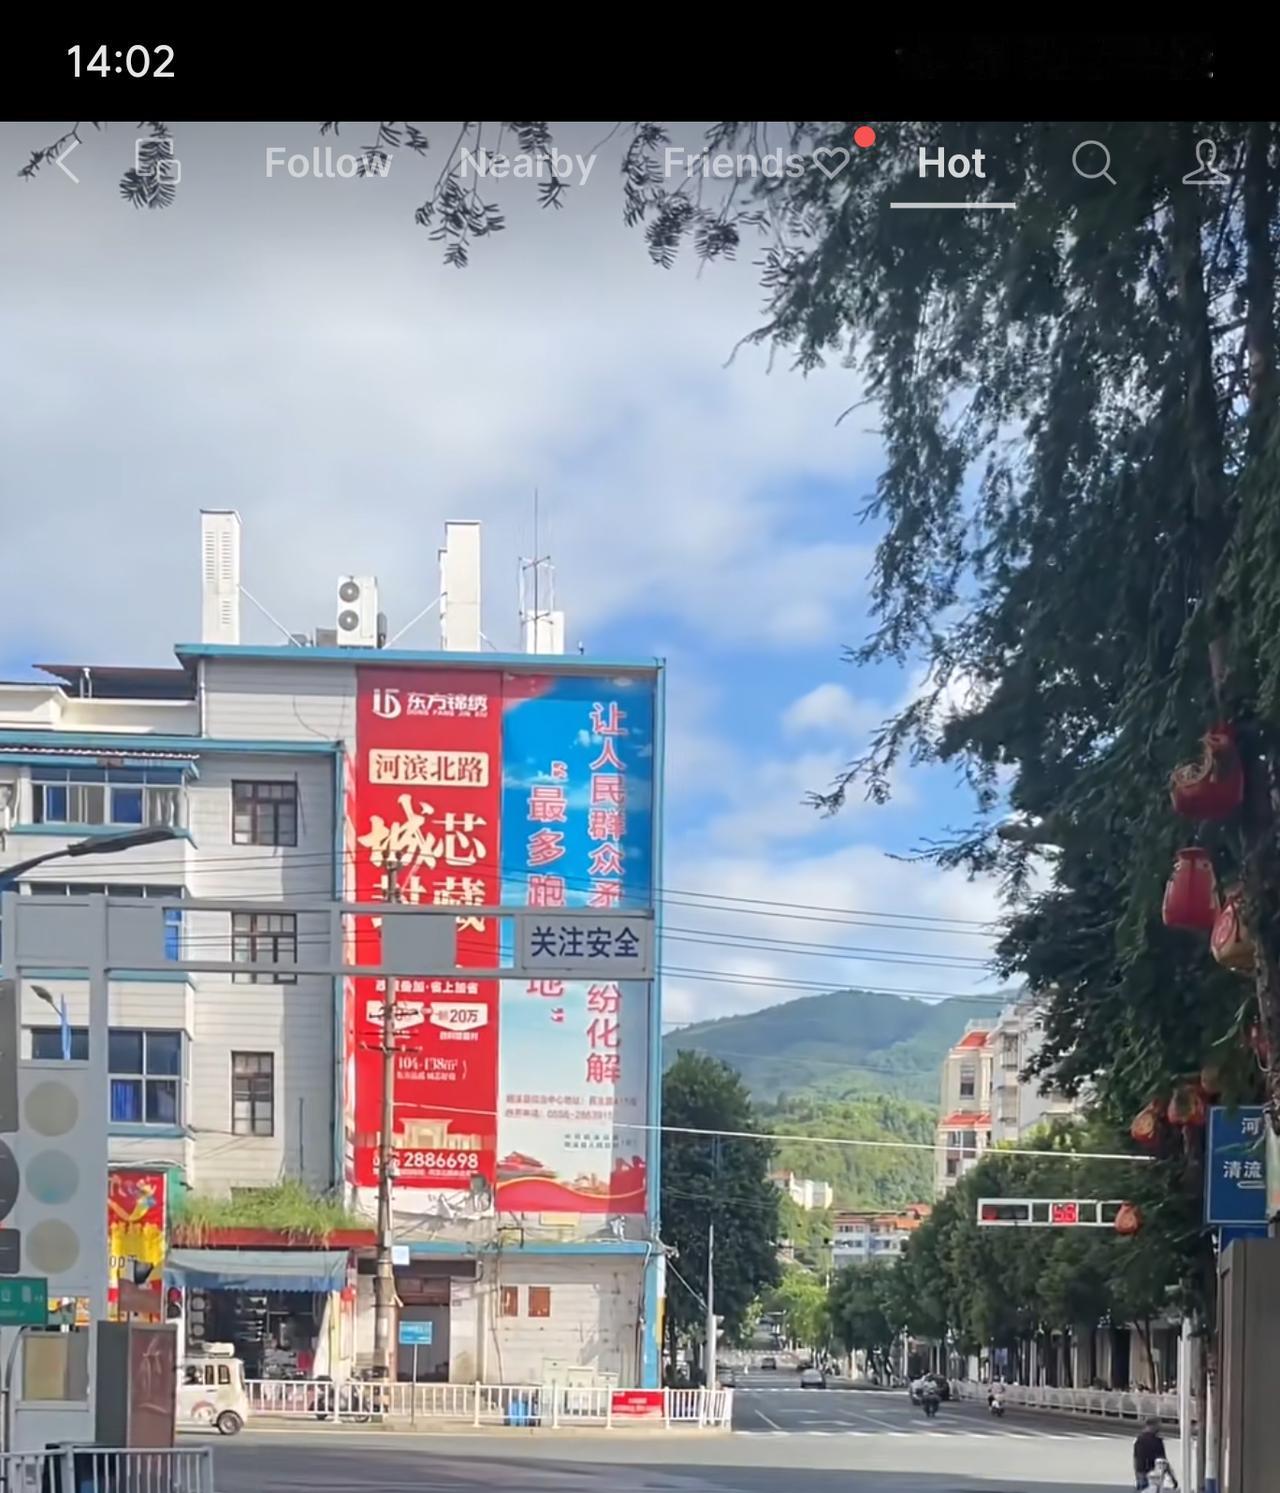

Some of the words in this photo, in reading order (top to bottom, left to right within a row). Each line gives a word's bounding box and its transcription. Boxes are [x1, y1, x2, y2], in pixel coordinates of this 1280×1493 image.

[407, 693, 488, 712] 东方锦绣
[376, 754, 483, 784] 河滨北路
[586, 701, 627, 1085] 让人民群众矛纷化解
[531, 926, 640, 959] 关注安全
[1241, 1116, 1261, 1135] 河
[404, 1152, 479, 1169] 2886698
[1223, 1160, 1263, 1179] 清流
